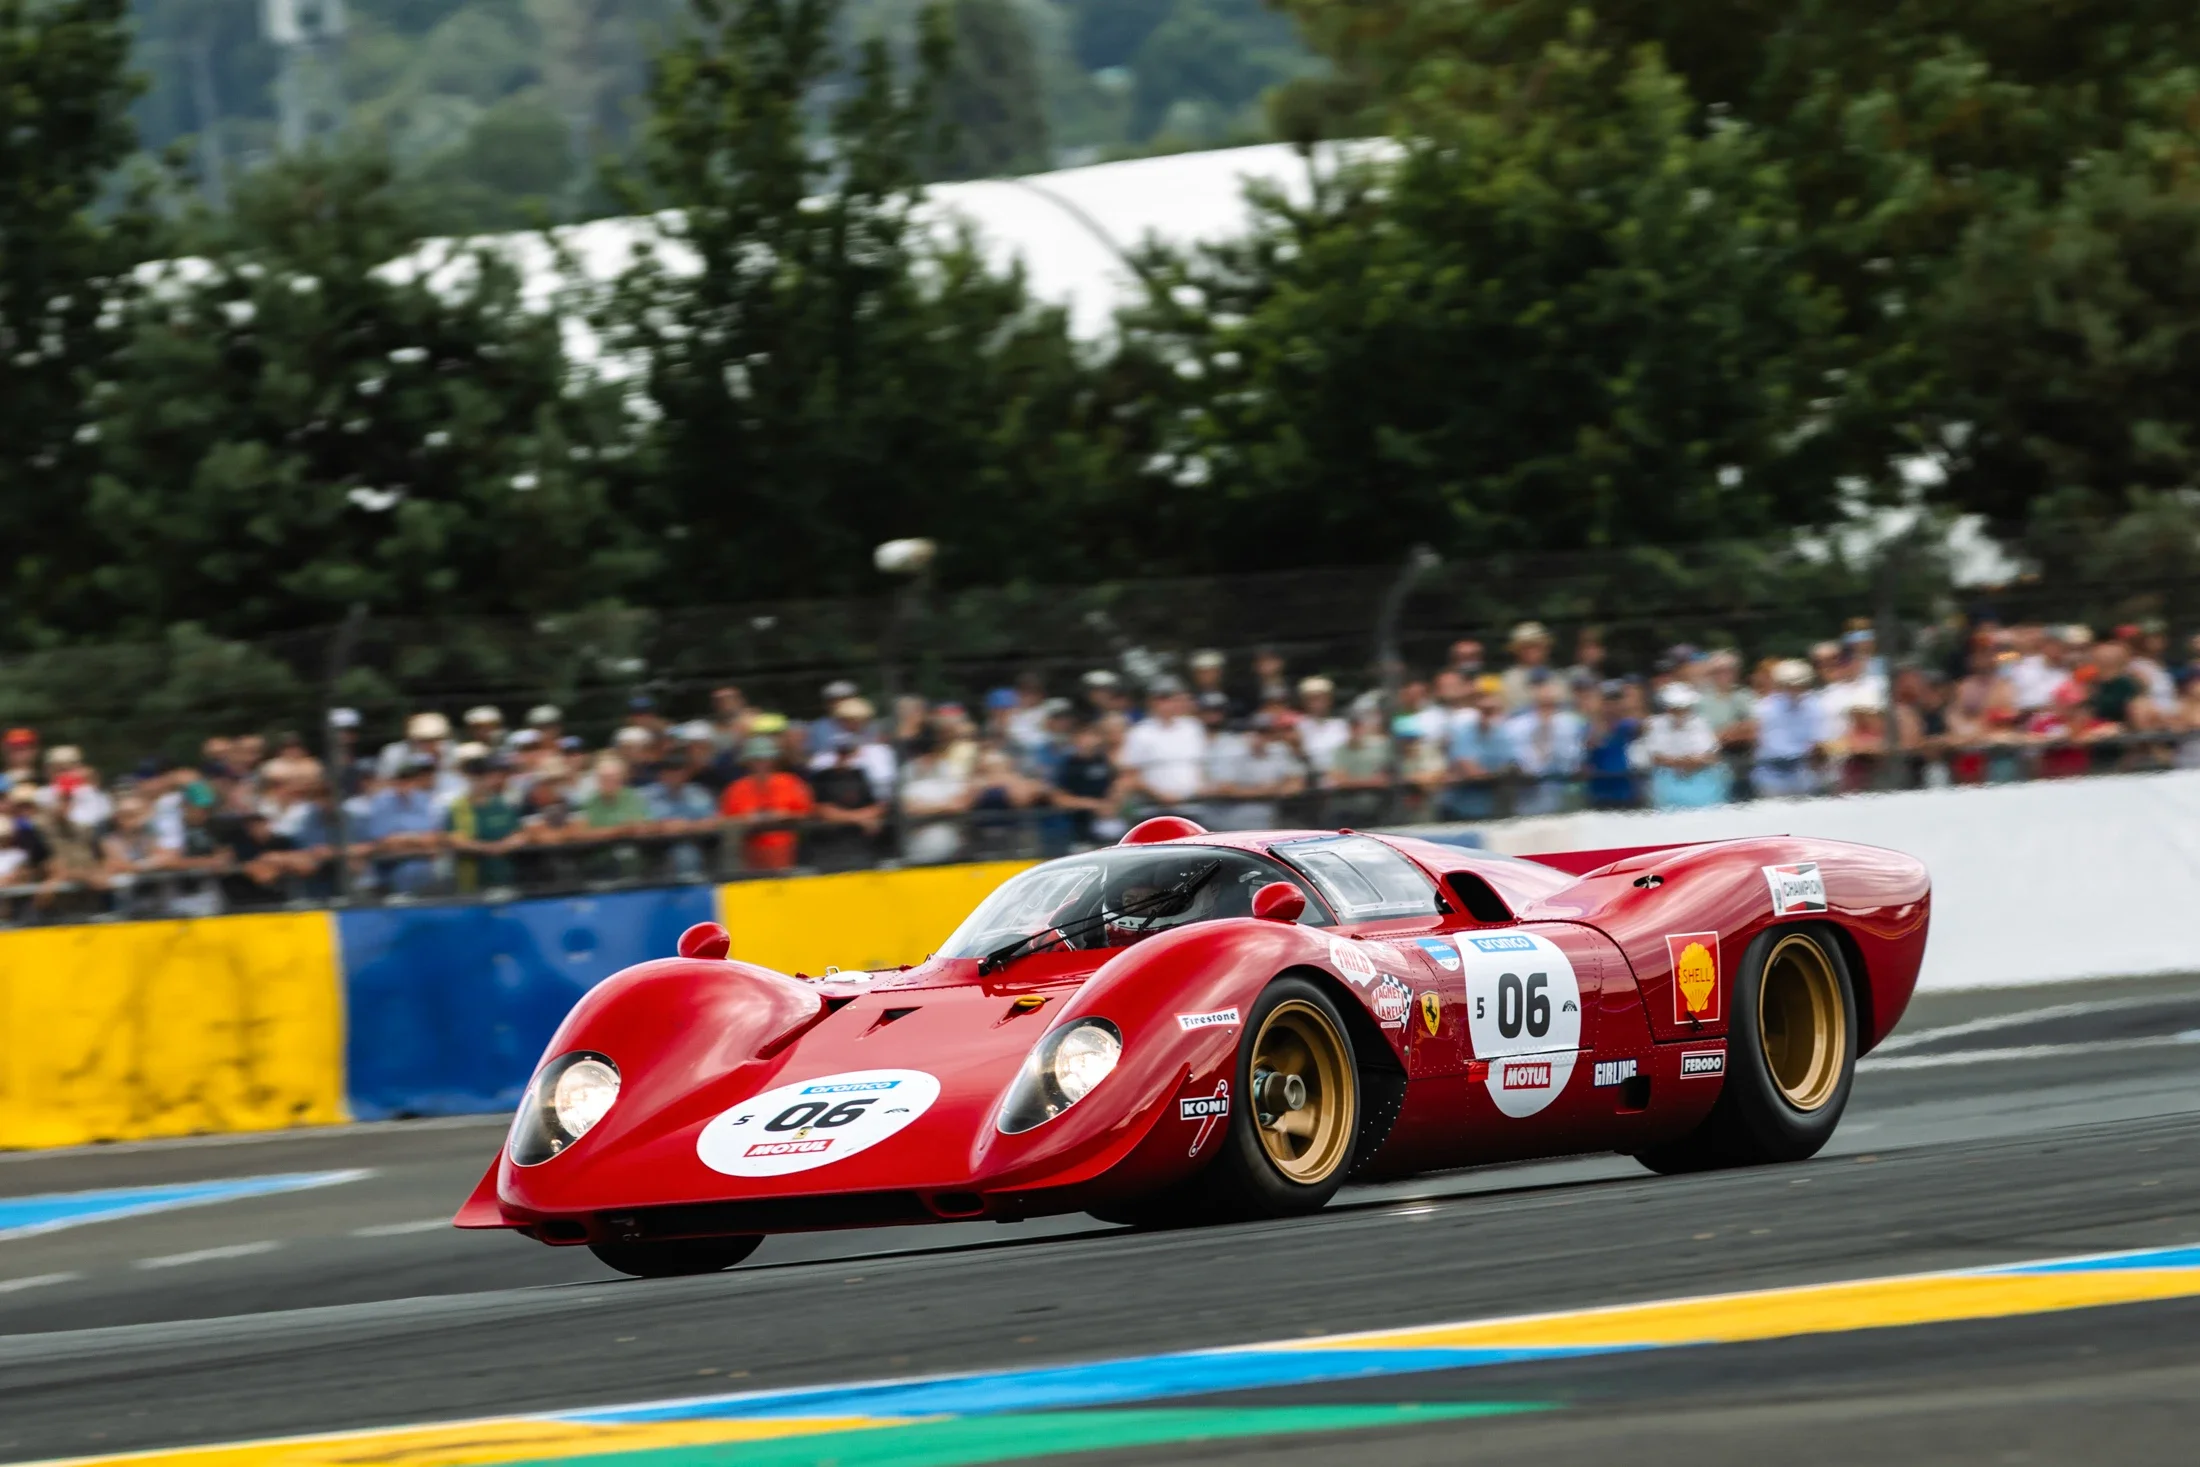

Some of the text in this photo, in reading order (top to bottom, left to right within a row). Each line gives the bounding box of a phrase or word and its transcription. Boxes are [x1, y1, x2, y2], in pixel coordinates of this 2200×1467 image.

[1783, 880, 1823, 897] CHAMPION
[1478, 936, 1531, 951] aramco
[1683, 967, 1711, 984] SHELL
[1476, 997, 1485, 1019] 5
[1498, 972, 1550, 1039] 06
[1182, 1011, 1236, 1028] Firestone
[1594, 1059, 1637, 1086] GIRLING
[1684, 1057, 1722, 1072] FERODO
[1505, 1067, 1549, 1086] MOTUL
[810, 1081, 893, 1093] aramco
[764, 1098, 881, 1132] 06
[1184, 1099, 1228, 1115] KONI
[732, 1115, 755, 1126] 5
[748, 1139, 829, 1156] MOTUL
